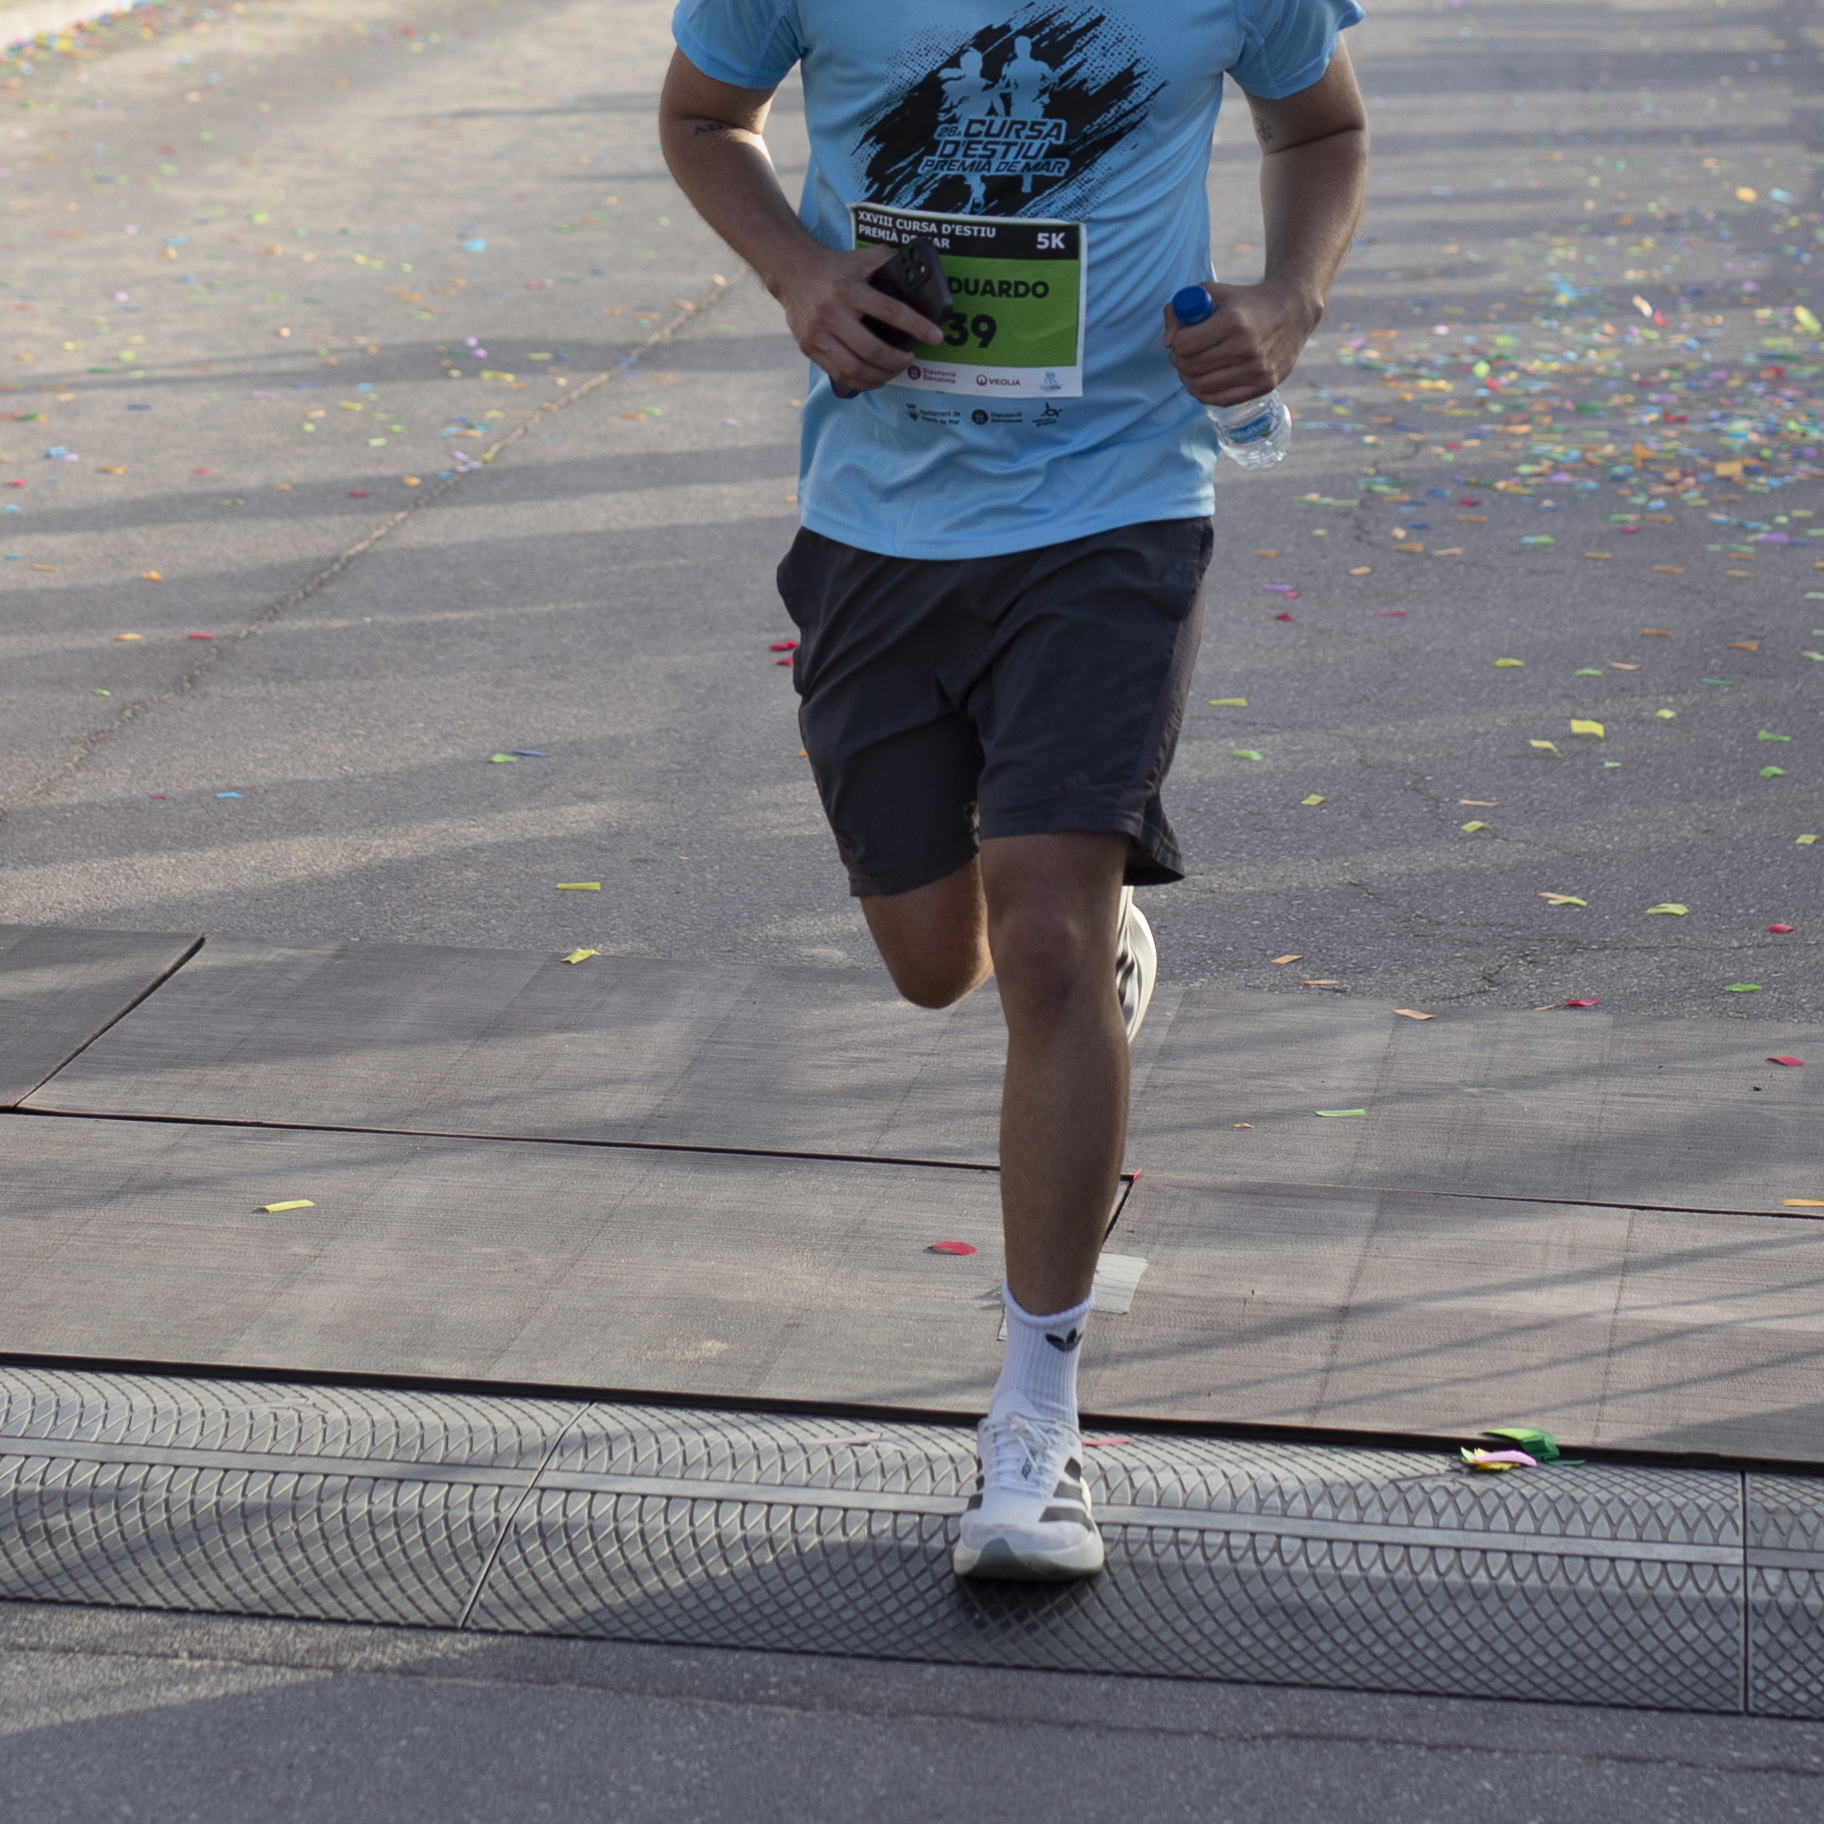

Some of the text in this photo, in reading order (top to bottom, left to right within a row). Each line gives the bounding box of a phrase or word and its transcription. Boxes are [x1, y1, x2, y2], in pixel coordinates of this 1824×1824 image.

[963, 118, 1064, 144] CURSA
[938, 139, 1046, 161] D'ESTIU
[994, 160, 1021, 173] DE
[1021, 160, 1067, 174] MAR
[857, 209, 1066, 249] XXVIII CURSA D'ESTIU 5K
[857, 223, 899, 243] PREMIÀ
[921, 234, 951, 249] AR
[947, 277, 1050, 299] DUARDO
[988, 377, 1022, 386] VEOLIA
